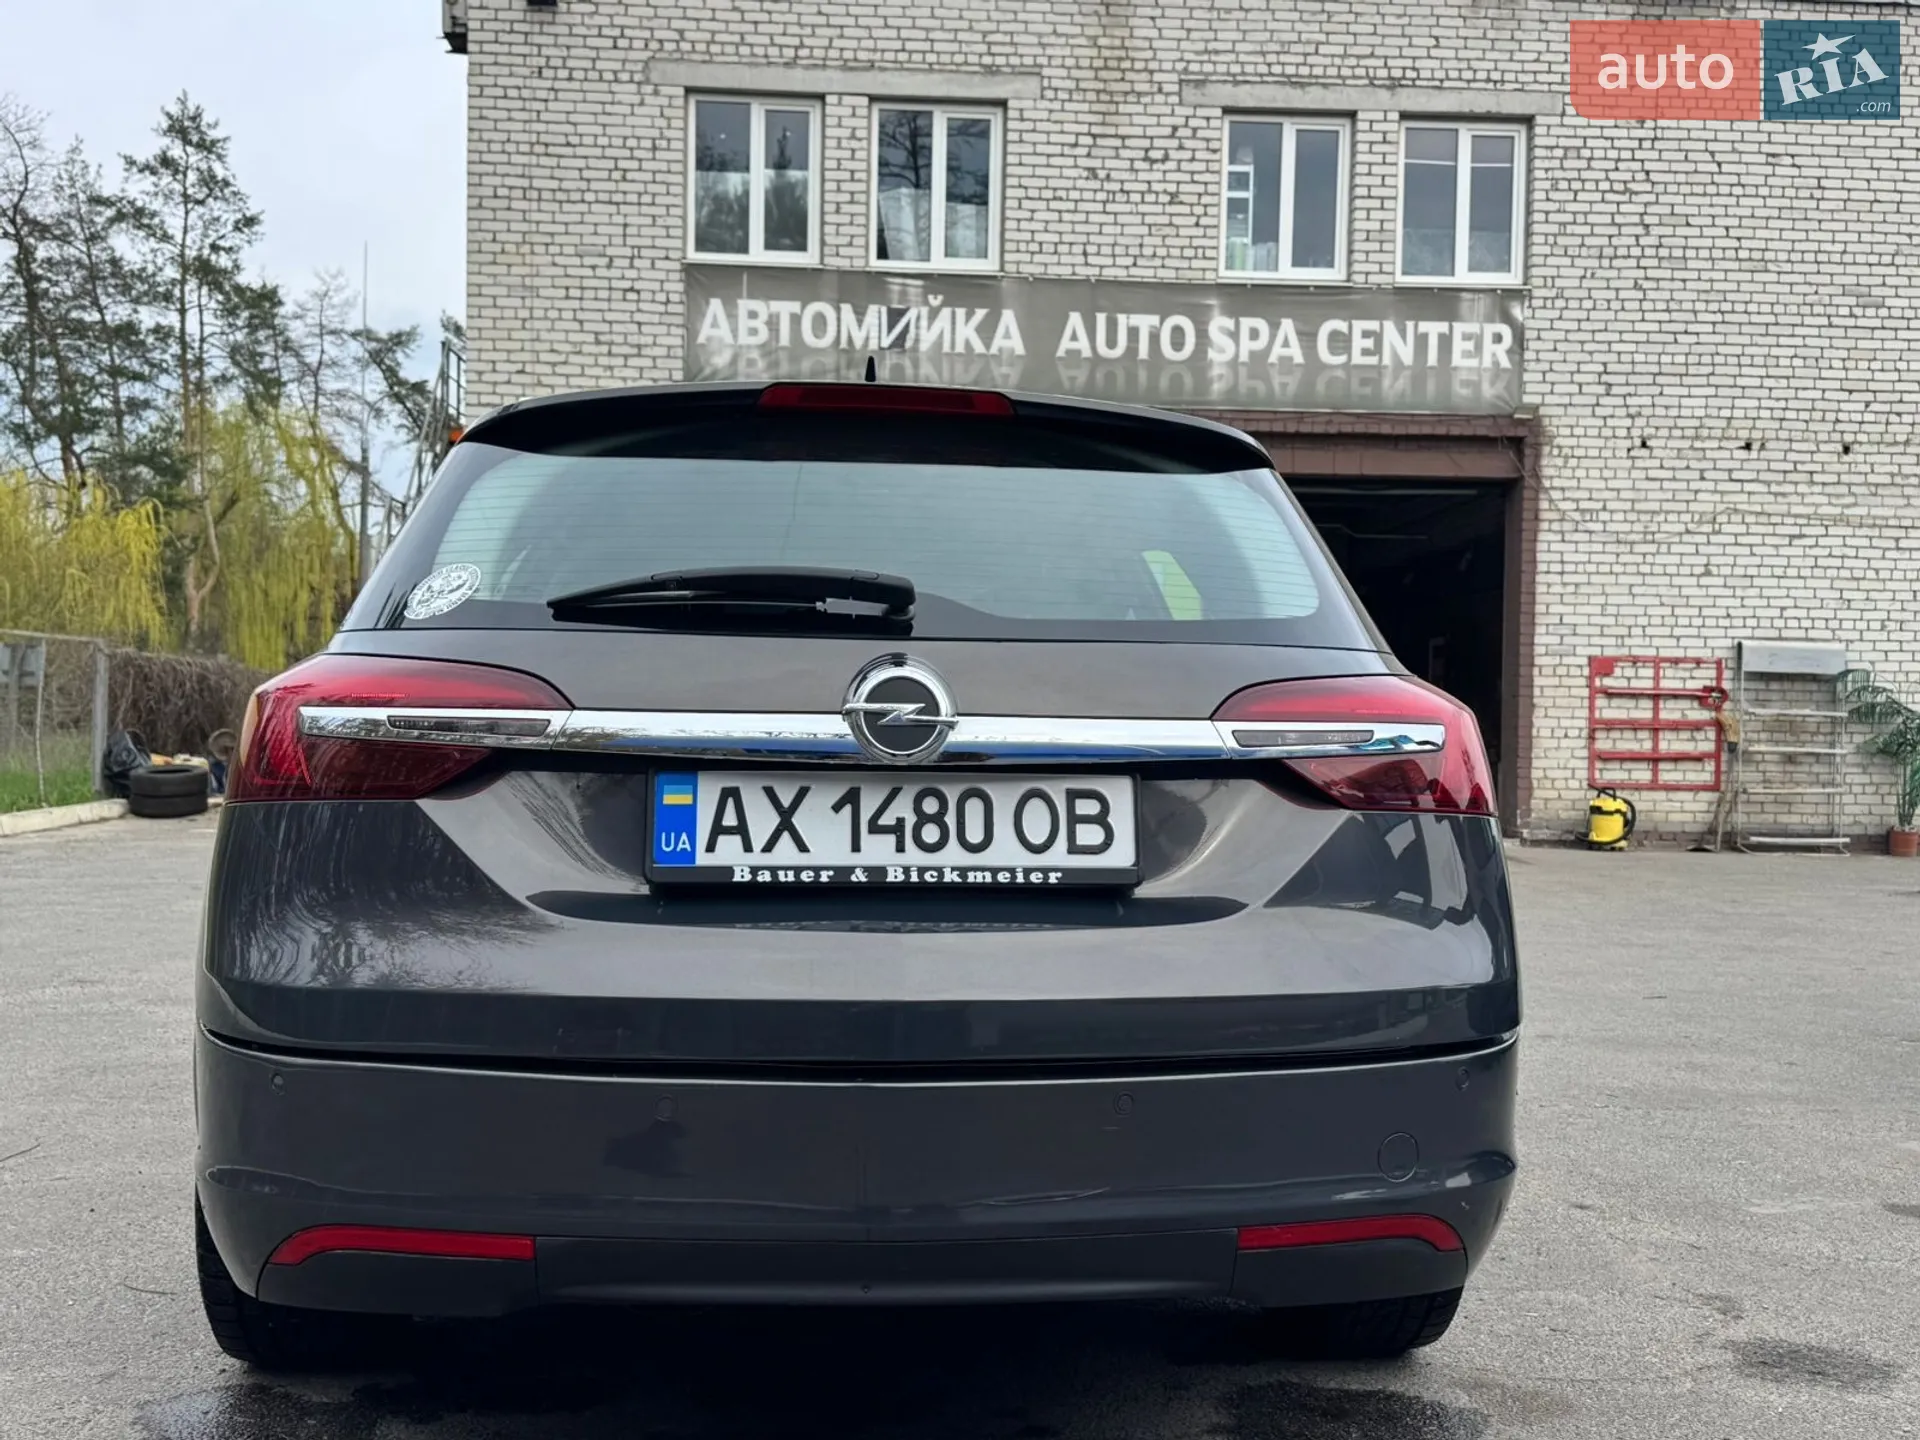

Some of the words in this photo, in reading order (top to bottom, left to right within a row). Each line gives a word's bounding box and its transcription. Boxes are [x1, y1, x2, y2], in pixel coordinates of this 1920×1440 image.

[696, 294, 1026, 356] АВТОМИЙКА
[1055, 311, 1196, 362] AUTO
[1207, 316, 1305, 364] SPA
[1316, 320, 1513, 370] CENTER
[661, 832, 691, 852] UA
[705, 785, 811, 853] AX
[830, 786, 994, 854] 1480
[732, 866, 834, 883] Bauer
[850, 868, 868, 882] &
[886, 866, 1063, 884] Bickmeier
